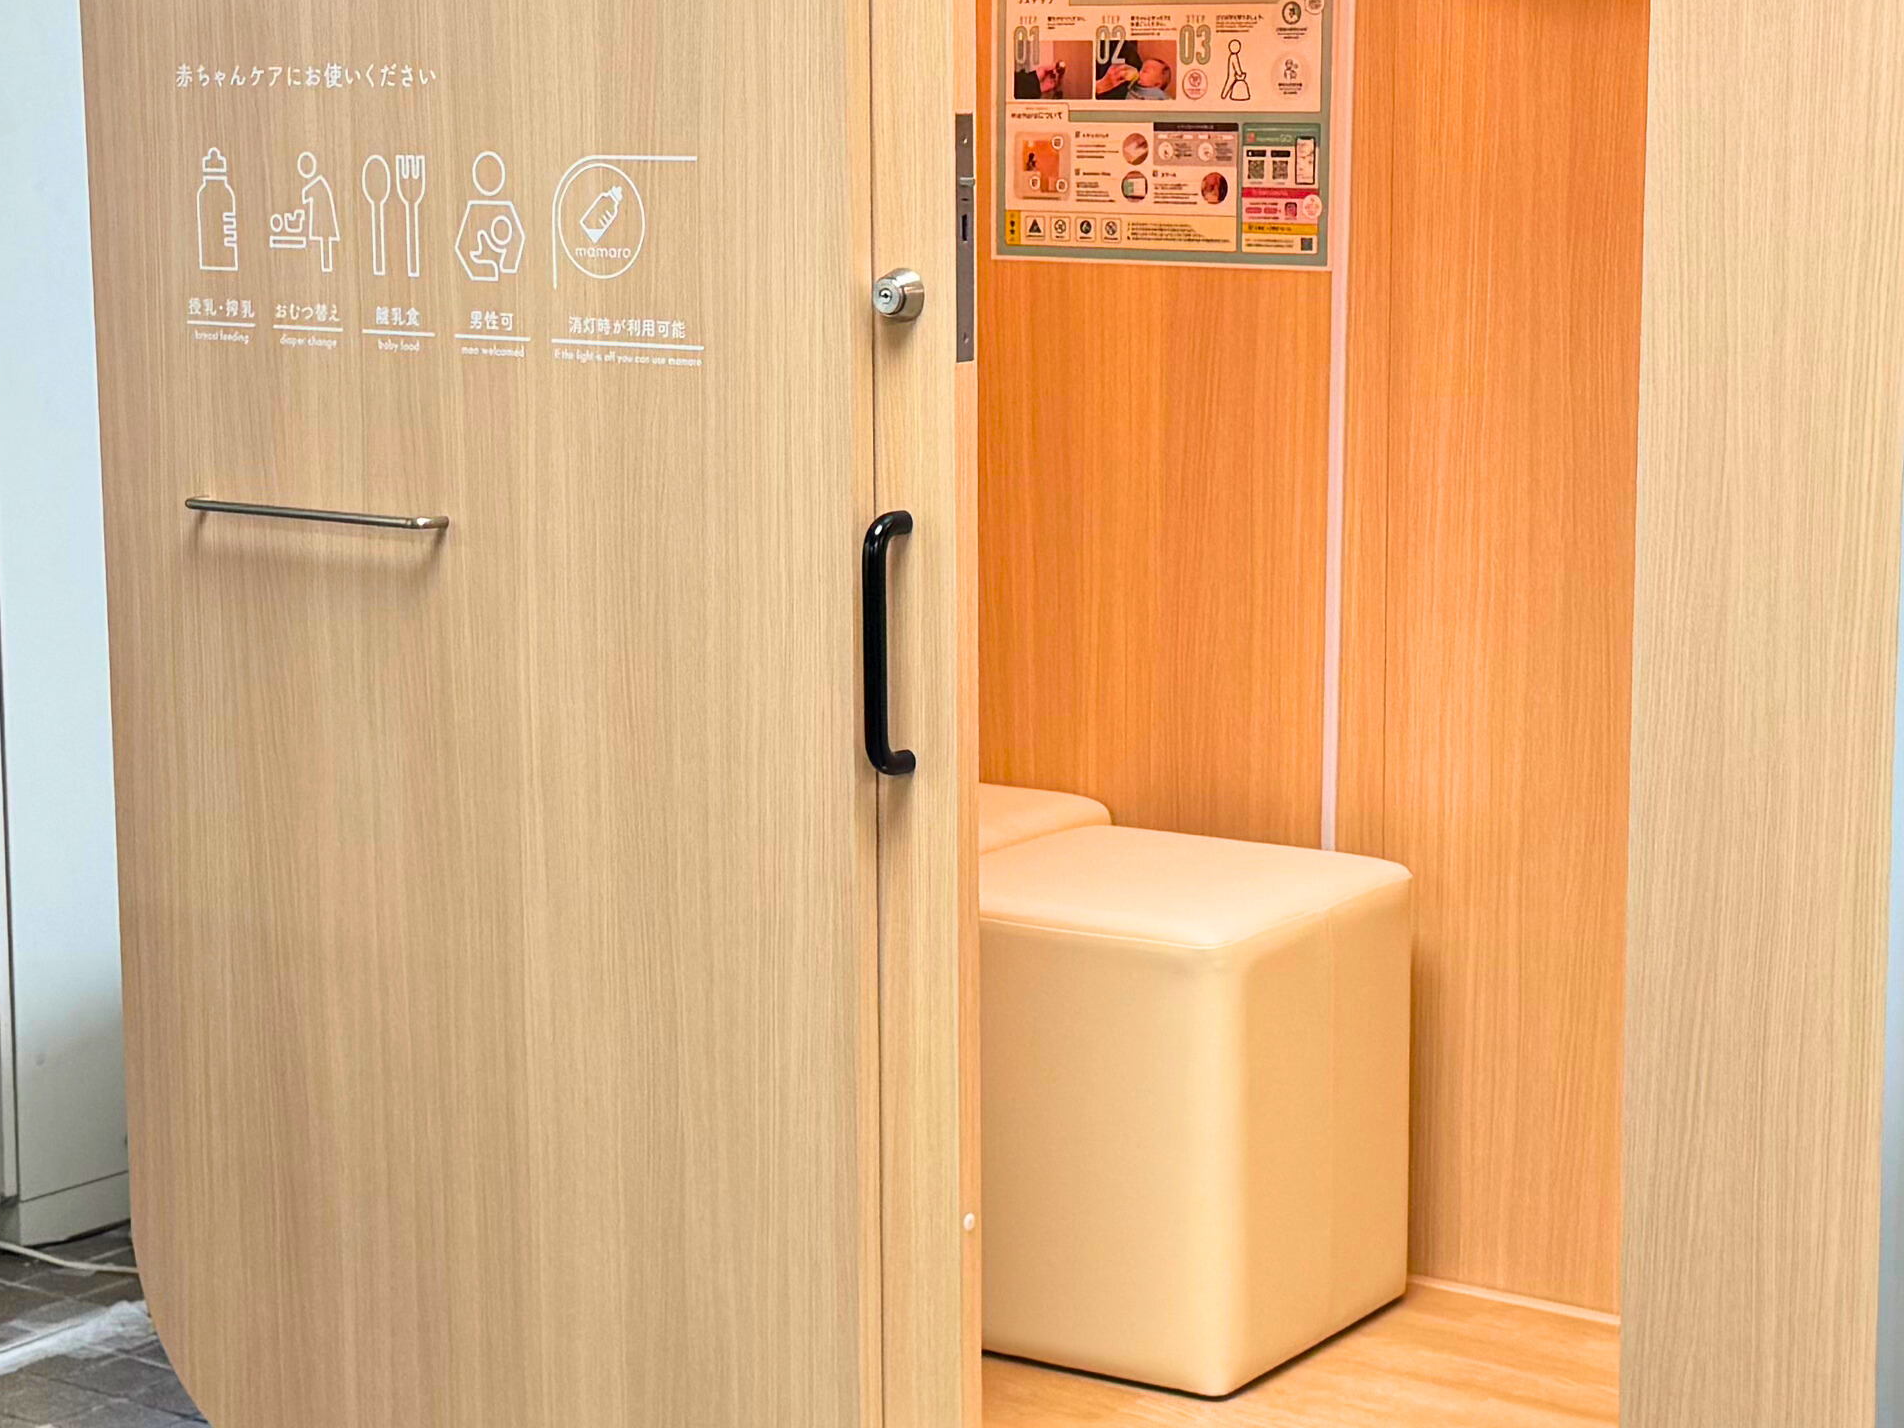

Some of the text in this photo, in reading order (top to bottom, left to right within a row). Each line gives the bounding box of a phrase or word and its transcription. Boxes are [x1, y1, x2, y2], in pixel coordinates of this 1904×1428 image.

[1014, 25, 1040, 65] 01
[1096, 25, 1127, 65] 02
[1179, 24, 1212, 65] 03
[176, 62, 437, 88] 赤ちゃんケアにお使いください
[575, 246, 632, 259] mamaro
[274, 303, 341, 323] おむつ替え
[469, 310, 514, 332] 男性可
[568, 315, 687, 340] 消灯時が利用可能
